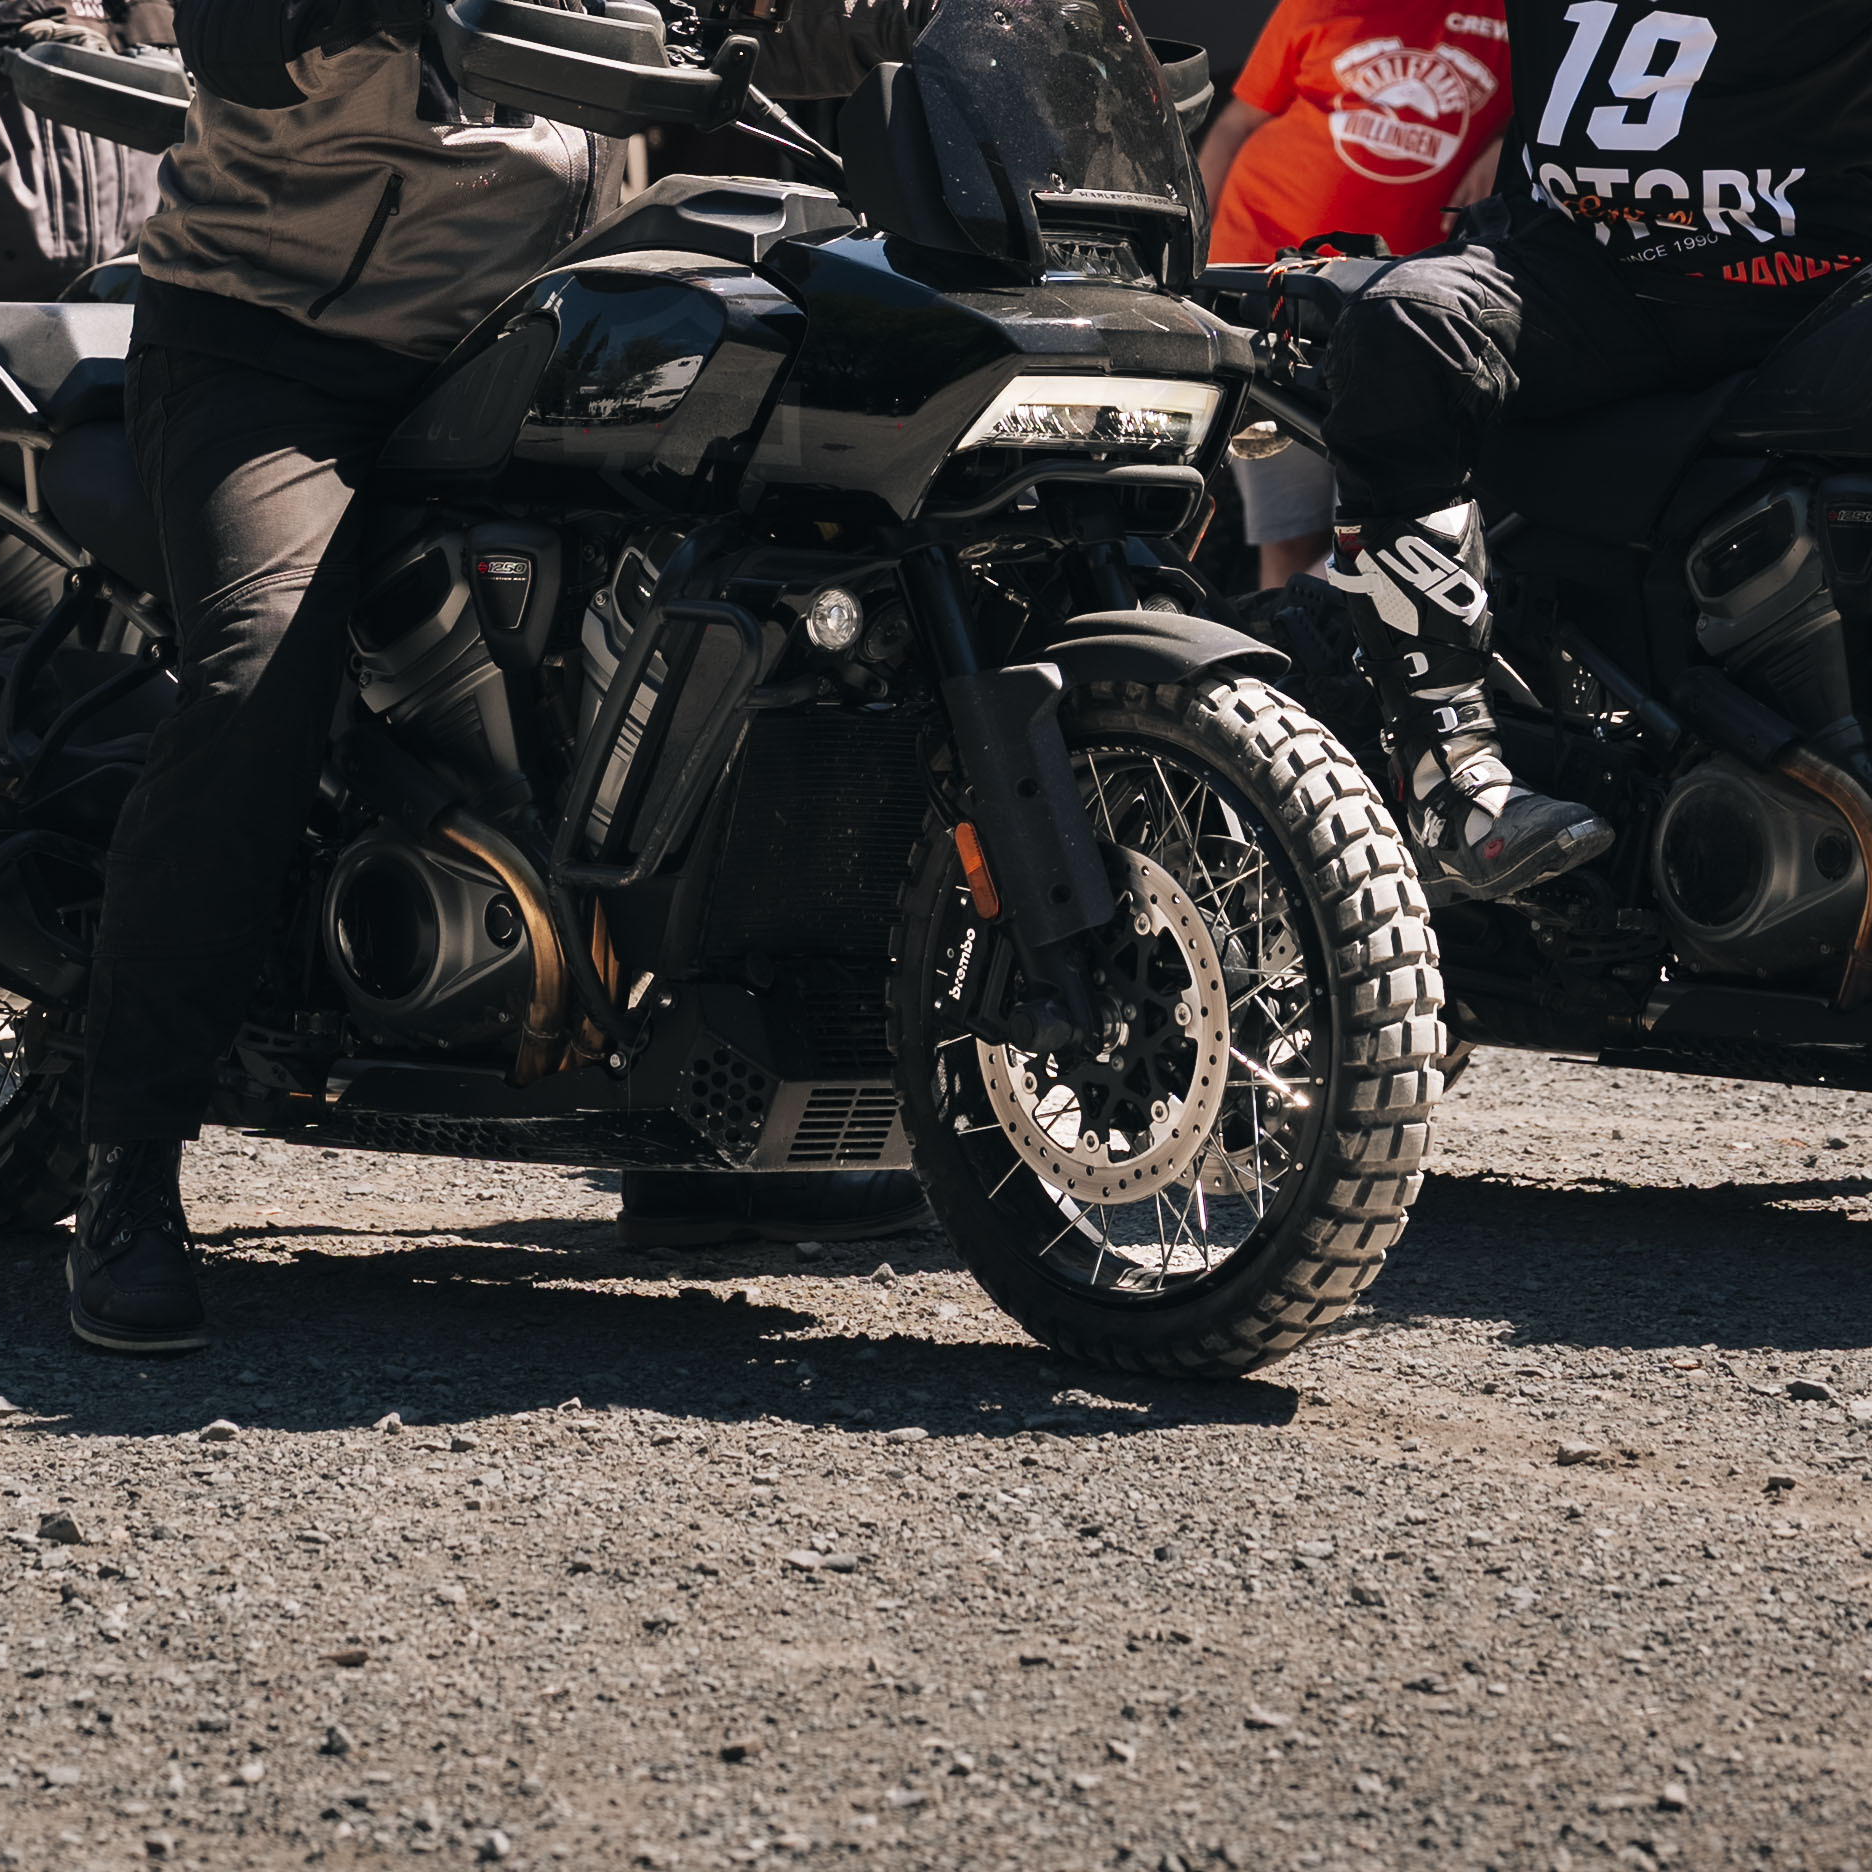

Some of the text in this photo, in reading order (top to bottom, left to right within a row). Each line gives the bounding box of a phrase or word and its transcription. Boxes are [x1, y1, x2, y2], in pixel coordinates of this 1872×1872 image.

[1536, 0, 1719, 152] 19
[488, 561, 528, 575] 1250
[948, 928, 976, 1001] brembo
